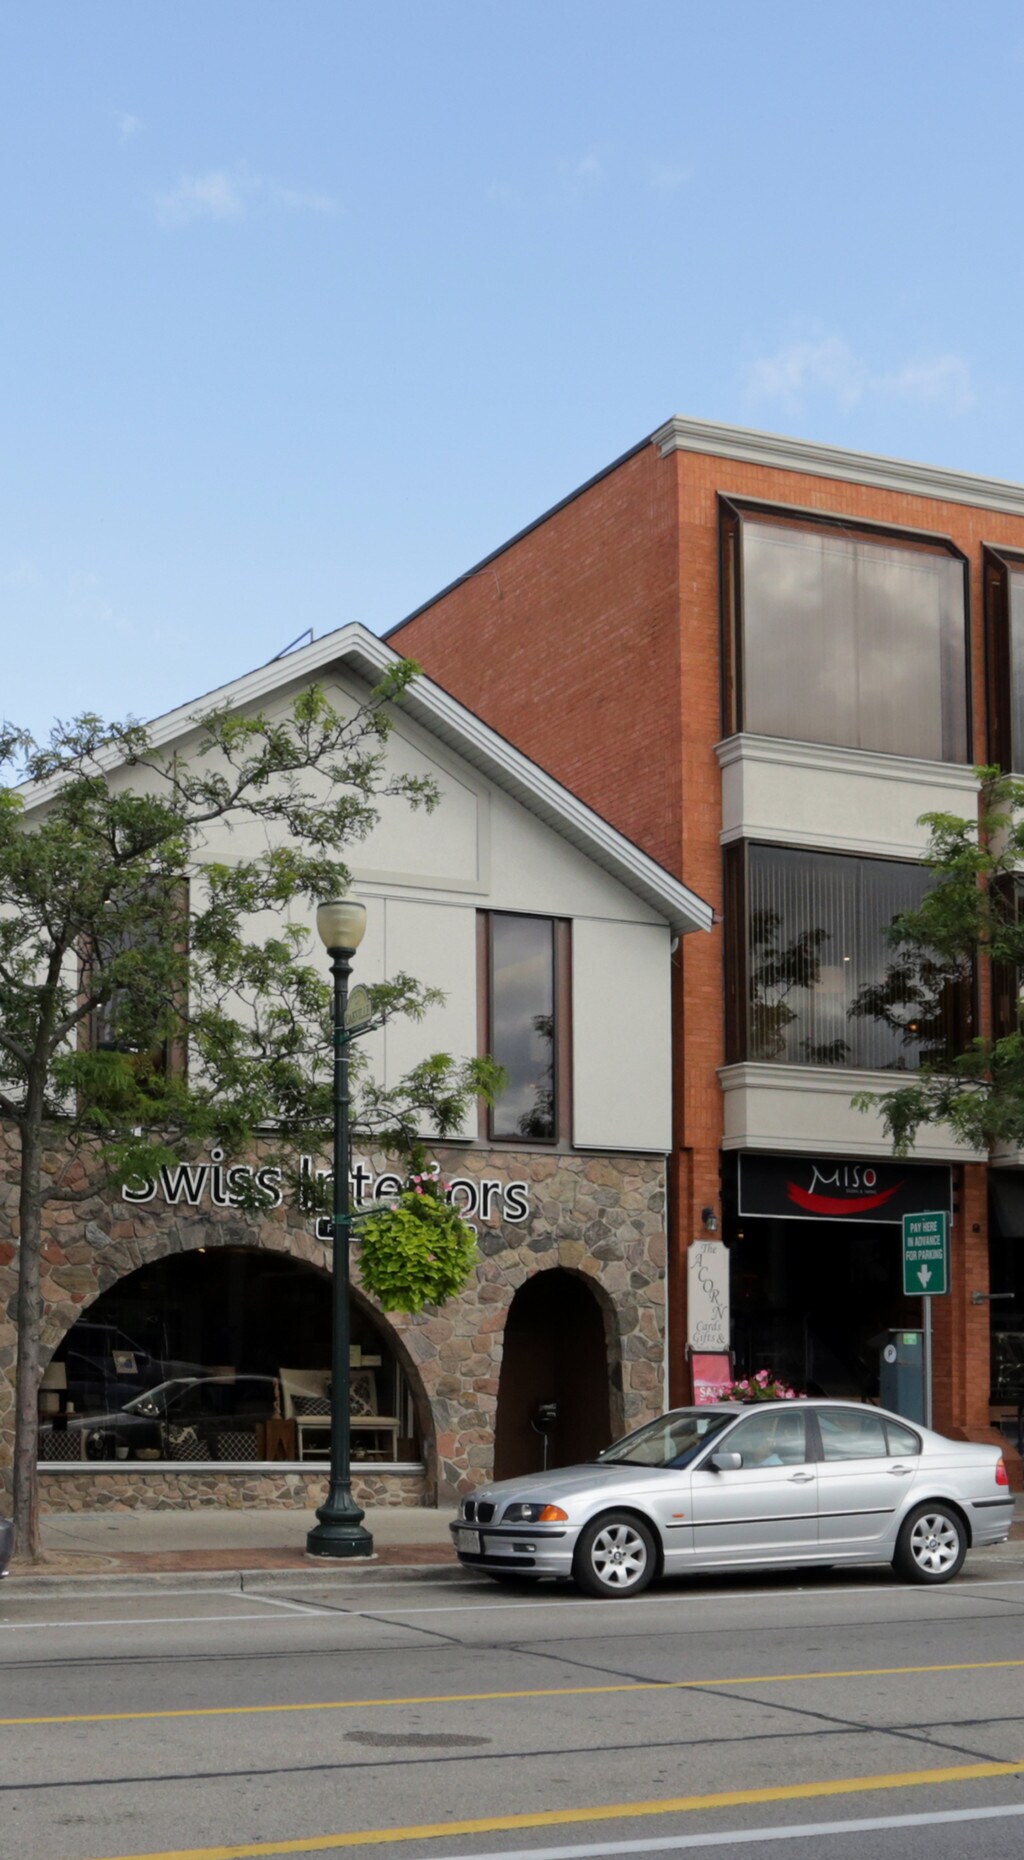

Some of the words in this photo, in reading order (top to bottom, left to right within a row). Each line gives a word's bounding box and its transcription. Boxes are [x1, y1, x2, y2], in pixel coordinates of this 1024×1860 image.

[122, 1148, 283, 1209] Swiss
[300, 1154, 530, 1223] Iteors
[808, 1165, 877, 1194] MISO
[910, 1222, 922, 1233] PAY
[922, 1220, 938, 1232] HERE
[907, 1237, 914, 1247] IN
[914, 1235, 941, 1247] ADVANCE
[700, 1243, 717, 1254] The
[905, 1250, 918, 1261] FOR
[918, 1249, 943, 1260] PARKING
[696, 1321, 722, 1332] Cards
[692, 1332, 715, 1345] Gifts
[716, 1333, 725, 1344] &
